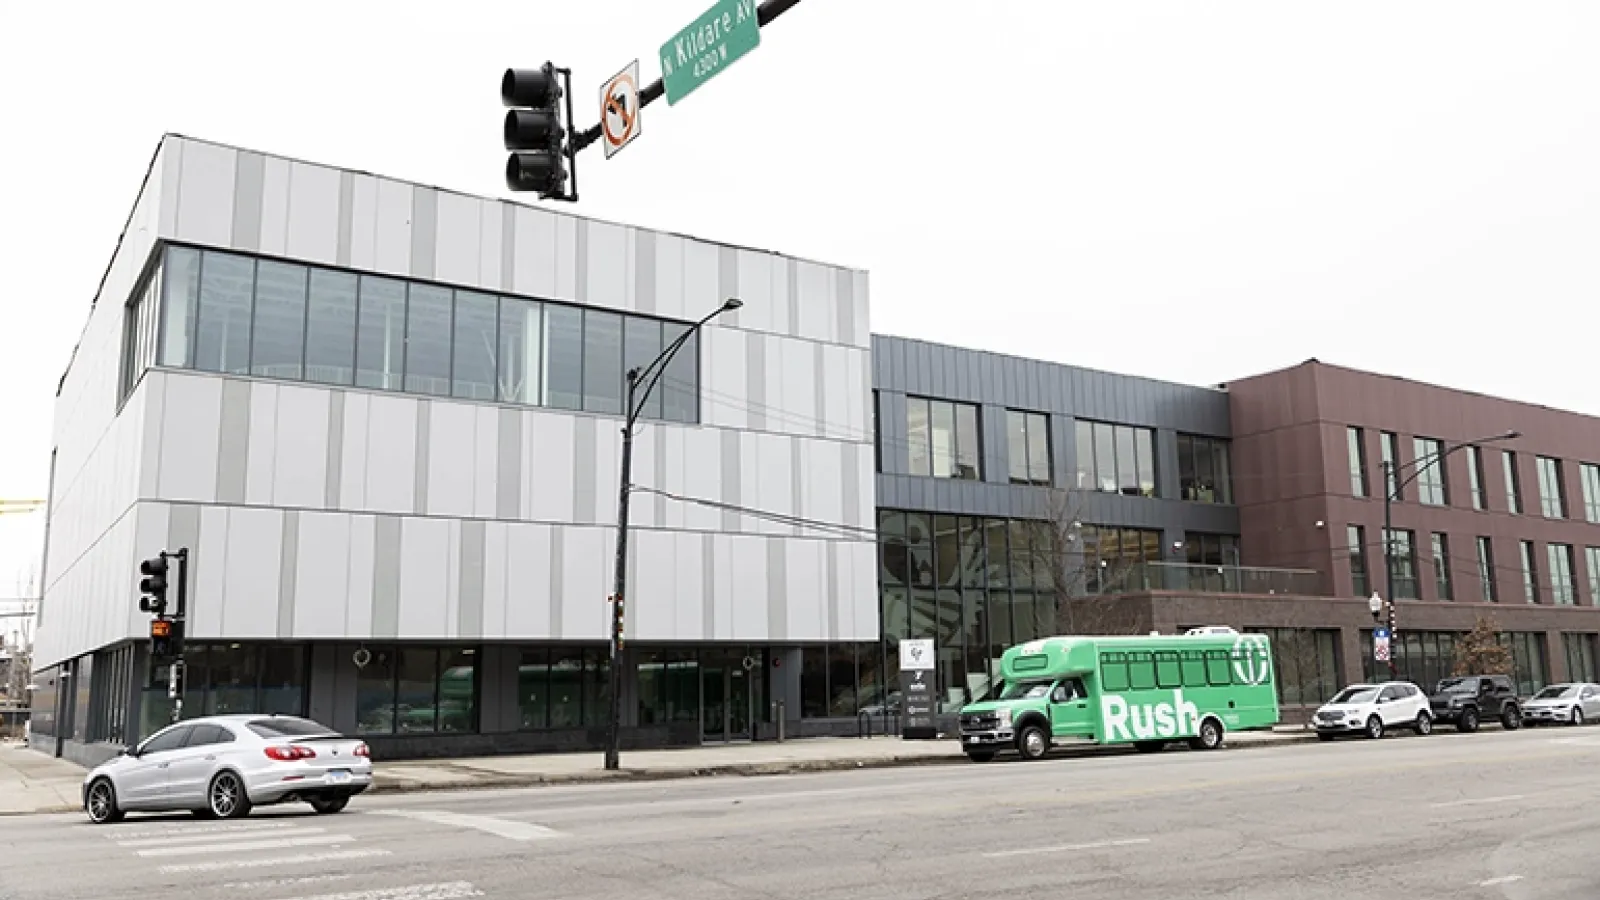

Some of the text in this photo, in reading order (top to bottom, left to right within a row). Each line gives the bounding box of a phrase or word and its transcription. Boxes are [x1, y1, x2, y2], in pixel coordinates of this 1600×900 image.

[663, 0, 754, 77] N Kildare AV
[693, 42, 728, 78] 4300 W
[1102, 689, 1198, 741] Rush
